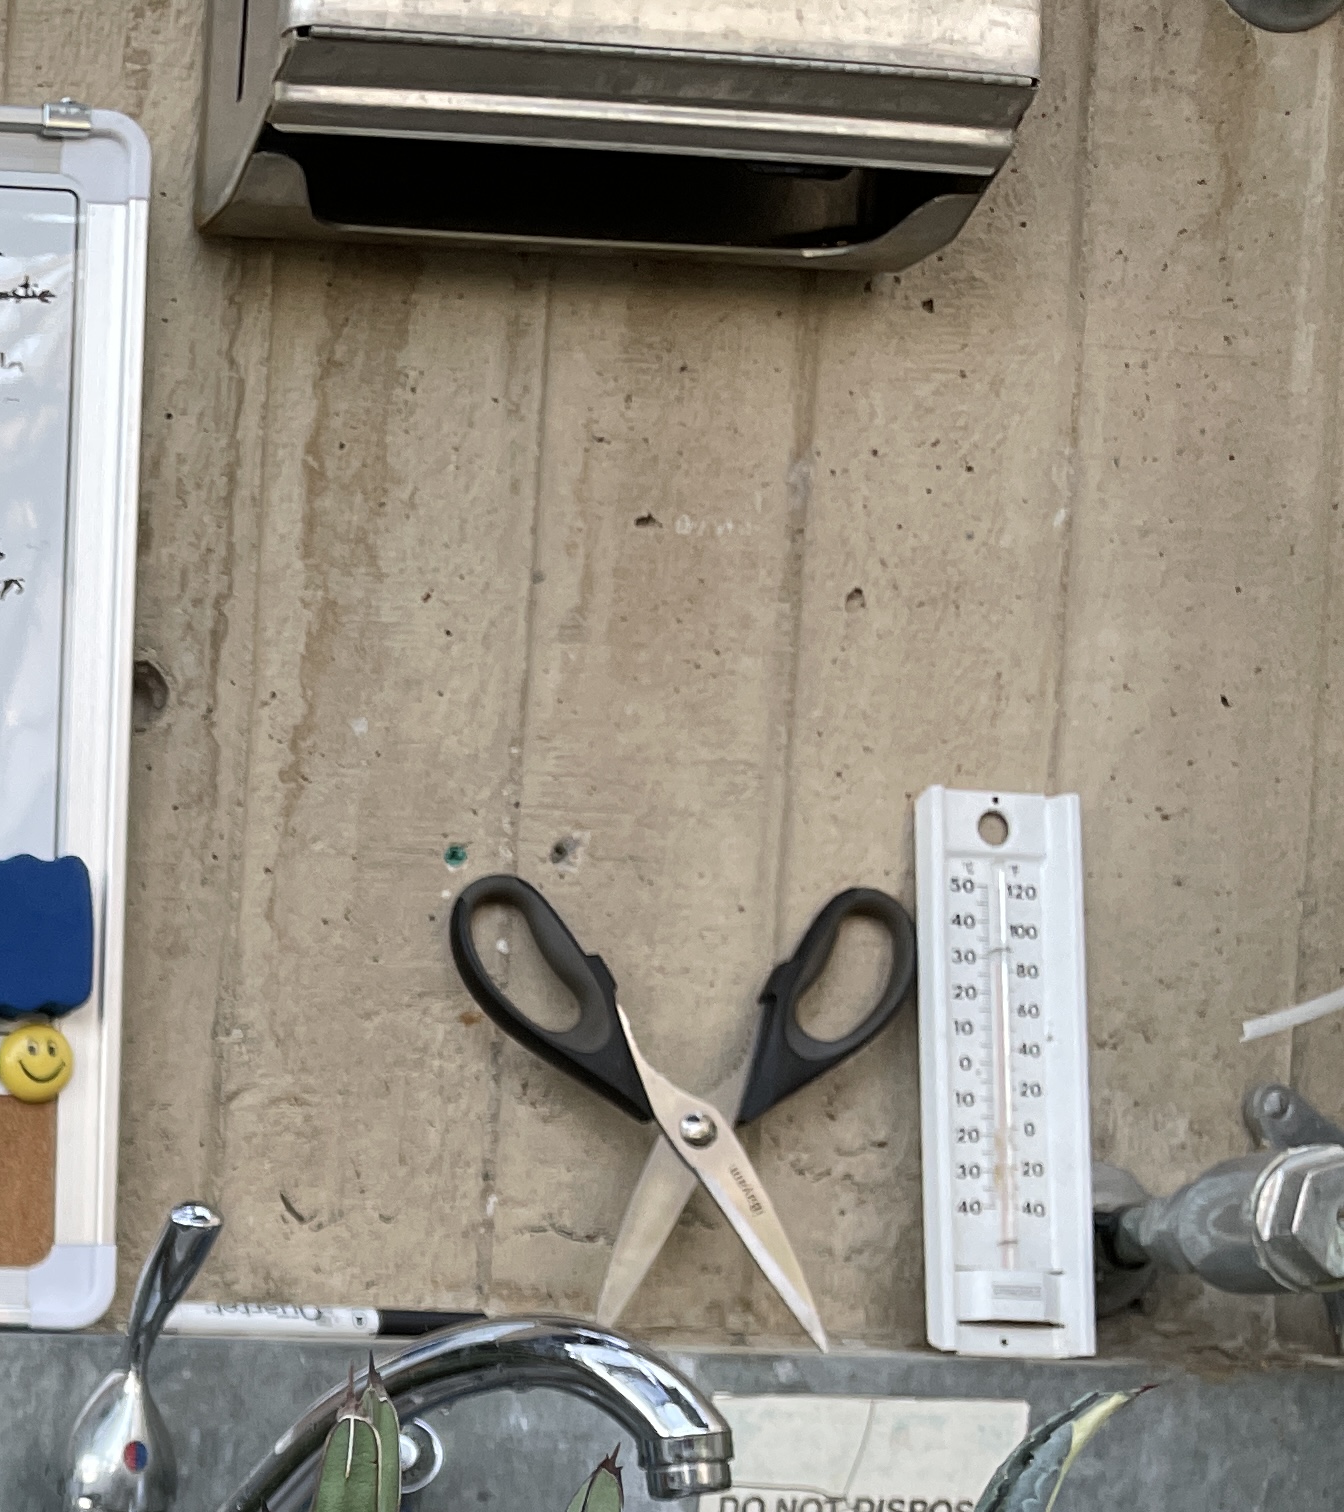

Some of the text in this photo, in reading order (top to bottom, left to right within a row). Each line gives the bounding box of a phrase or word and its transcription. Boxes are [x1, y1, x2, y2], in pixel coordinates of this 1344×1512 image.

[950, 879, 975, 893] 50
[1007, 885, 1036, 900] 120
[950, 914, 976, 929] 40
[1010, 925, 1038, 939] 100
[951, 950, 976, 964] 30
[1016, 965, 1039, 978] 80
[952, 985, 977, 999] 20
[1017, 1004, 1040, 1018] 60
[953, 1020, 973, 1035] 10
[1017, 1043, 1041, 1057] 40
[959, 1057, 972, 1071] 0
[1020, 1083, 1042, 1098] 20
[954, 1092, 975, 1107] 10
[957, 1127, 980, 1143] 20
[1023, 1122, 1036, 1137] 0
[955, 1164, 981, 1180] 30
[1022, 1162, 1044, 1177] 20
[957, 1200, 982, 1216] 40
[1022, 1202, 1045, 1217] 40
